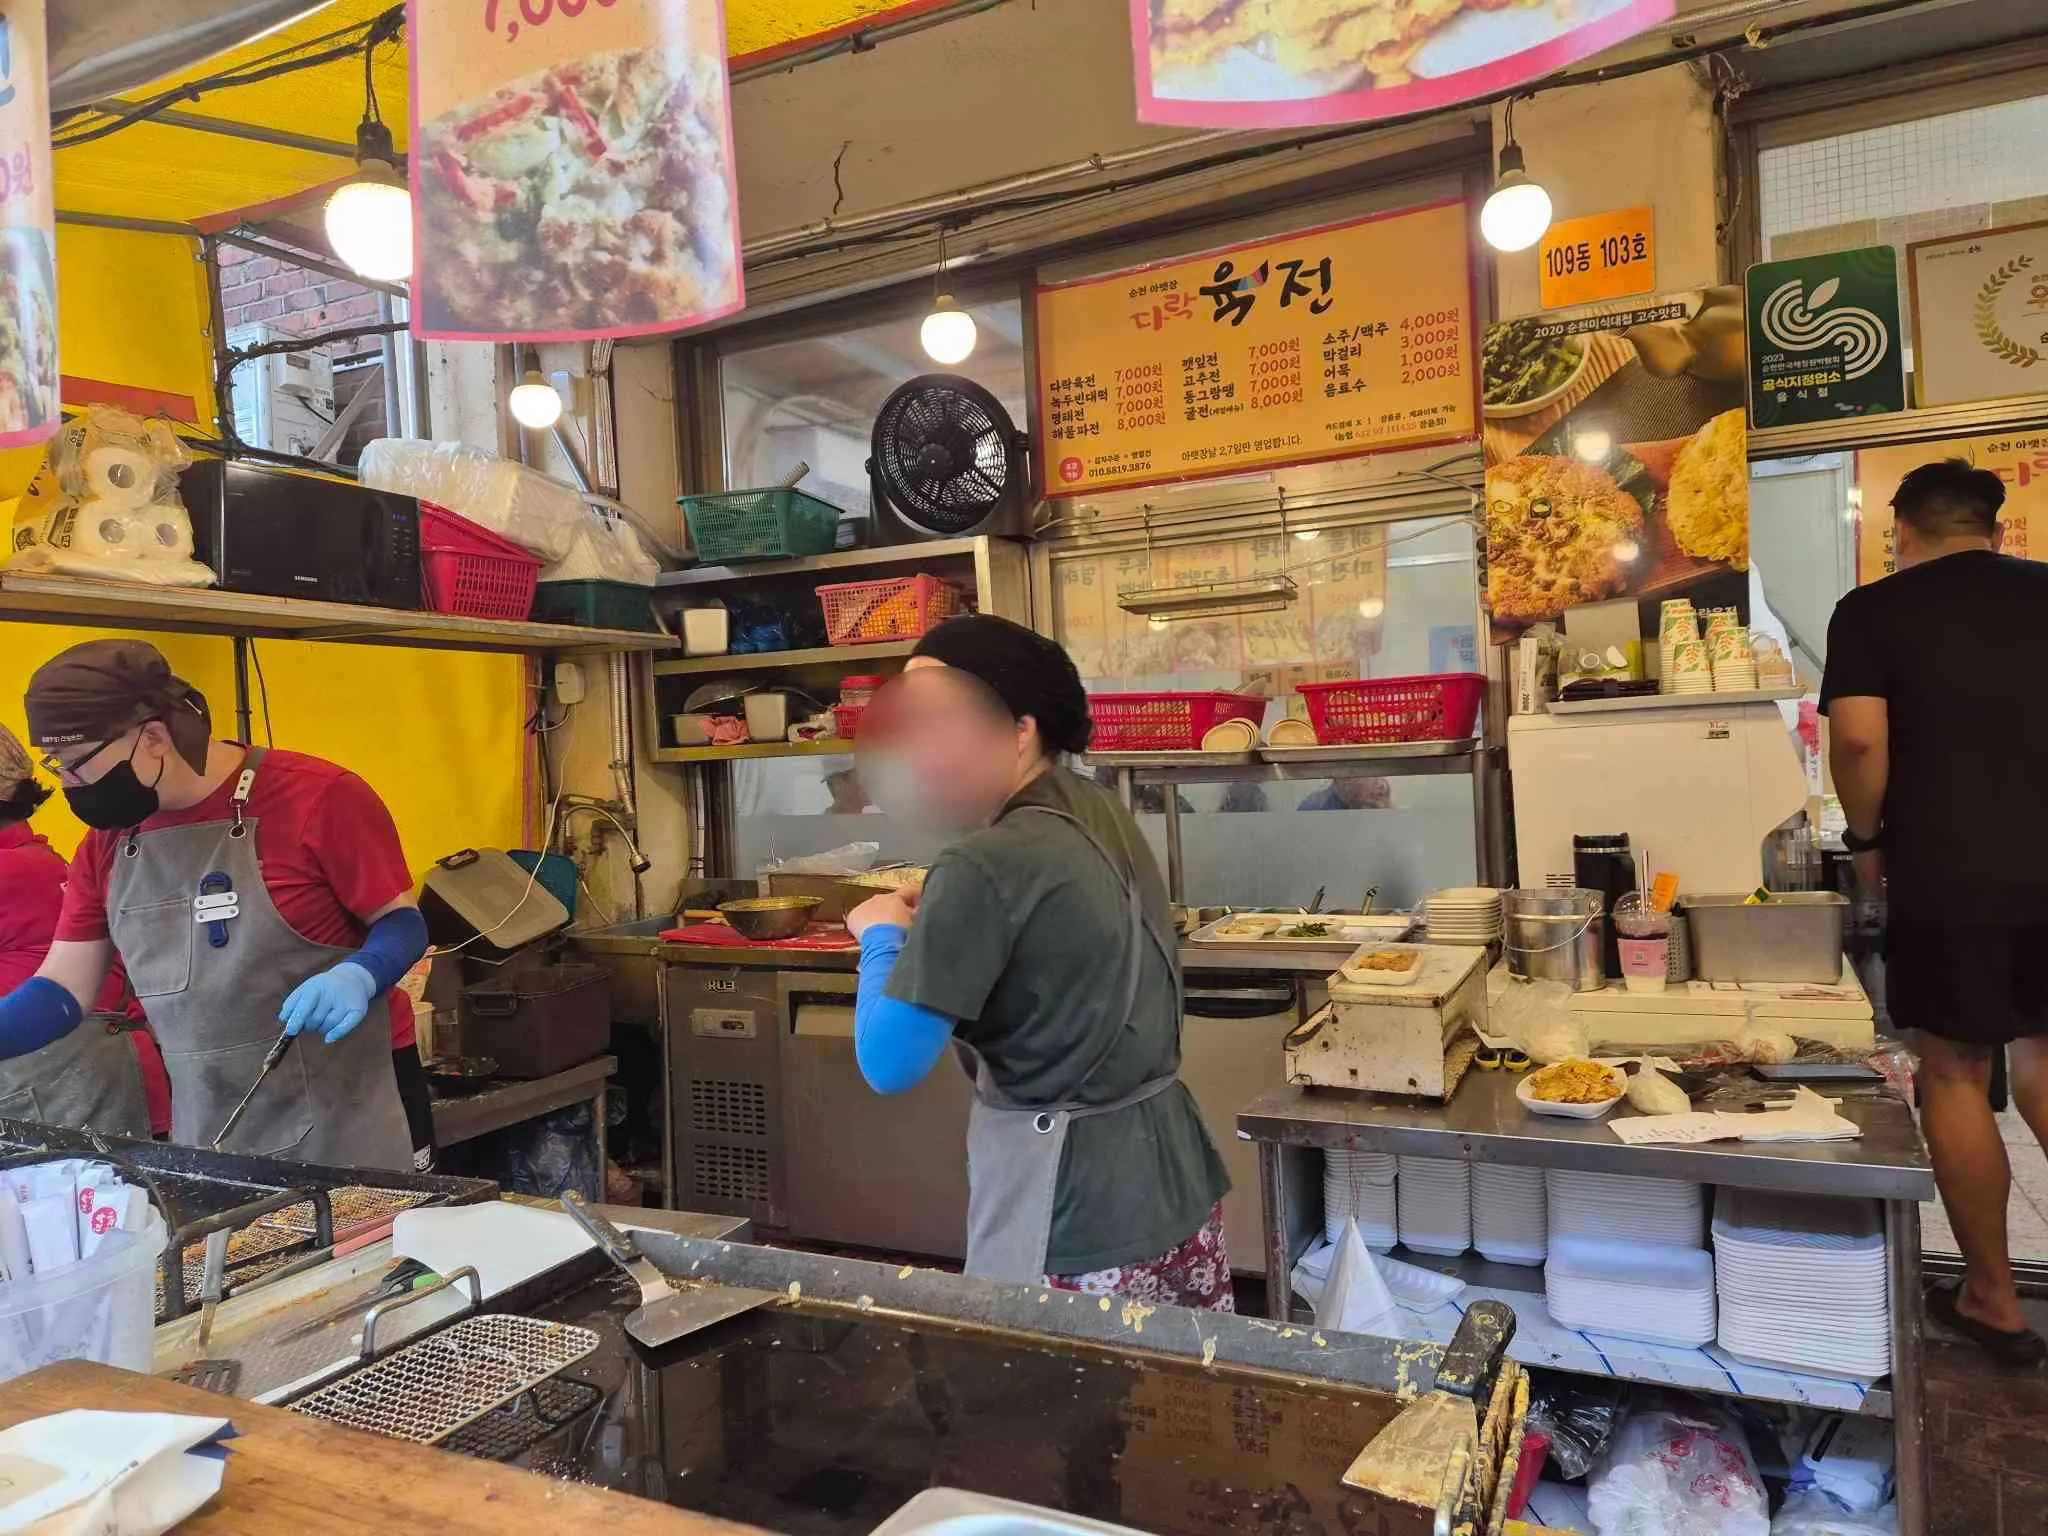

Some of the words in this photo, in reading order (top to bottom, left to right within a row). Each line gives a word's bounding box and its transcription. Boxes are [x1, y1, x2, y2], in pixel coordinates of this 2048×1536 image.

[1546, 242, 1591, 278] 109동
[1601, 232, 1647, 268] 103호
[1129, 286, 1147, 298] 순천
[1150, 279, 1178, 292] 아랫장
[1322, 321, 1390, 345] 소주/맥주
[1400, 307, 1459, 331] 4,000원
[1534, 325, 1564, 338] 2020
[1637, 303, 1682, 322] 고수맛집
[1182, 352, 1218, 372] 깻잎전
[1248, 337, 1300, 360] 7,000원
[1323, 343, 1362, 362] 막걸리
[1401, 325, 1459, 349] 3,000원
[1761, 353, 1784, 364] 2023
[1183, 368, 1221, 387] 고추전
[1249, 355, 1301, 377] 7,000원
[1324, 363, 1351, 380] 어묵
[1401, 343, 1458, 367] 1,000원
[1050, 373, 1096, 392] 다락육전
[1114, 362, 1163, 383] 7,000원
[1250, 371, 1301, 394] 7,000원
[1324, 378, 1367, 398] 음료수
[1401, 361, 1460, 385] 2,000원
[1762, 371, 1842, 391] 공식지정업소
[1051, 387, 1108, 408] 녹두빈대떡
[1115, 378, 1164, 399] 7,000원
[1251, 387, 1303, 411] 8,000원
[1051, 408, 1085, 425] 명태전
[1116, 395, 1165, 415] 7,000원
[1051, 422, 1101, 440] 해물파전
[1117, 411, 1167, 431] 8,000원
[1253, 434, 1303, 451] 영업합니다.
[1987, 441, 2011, 453] 순천
